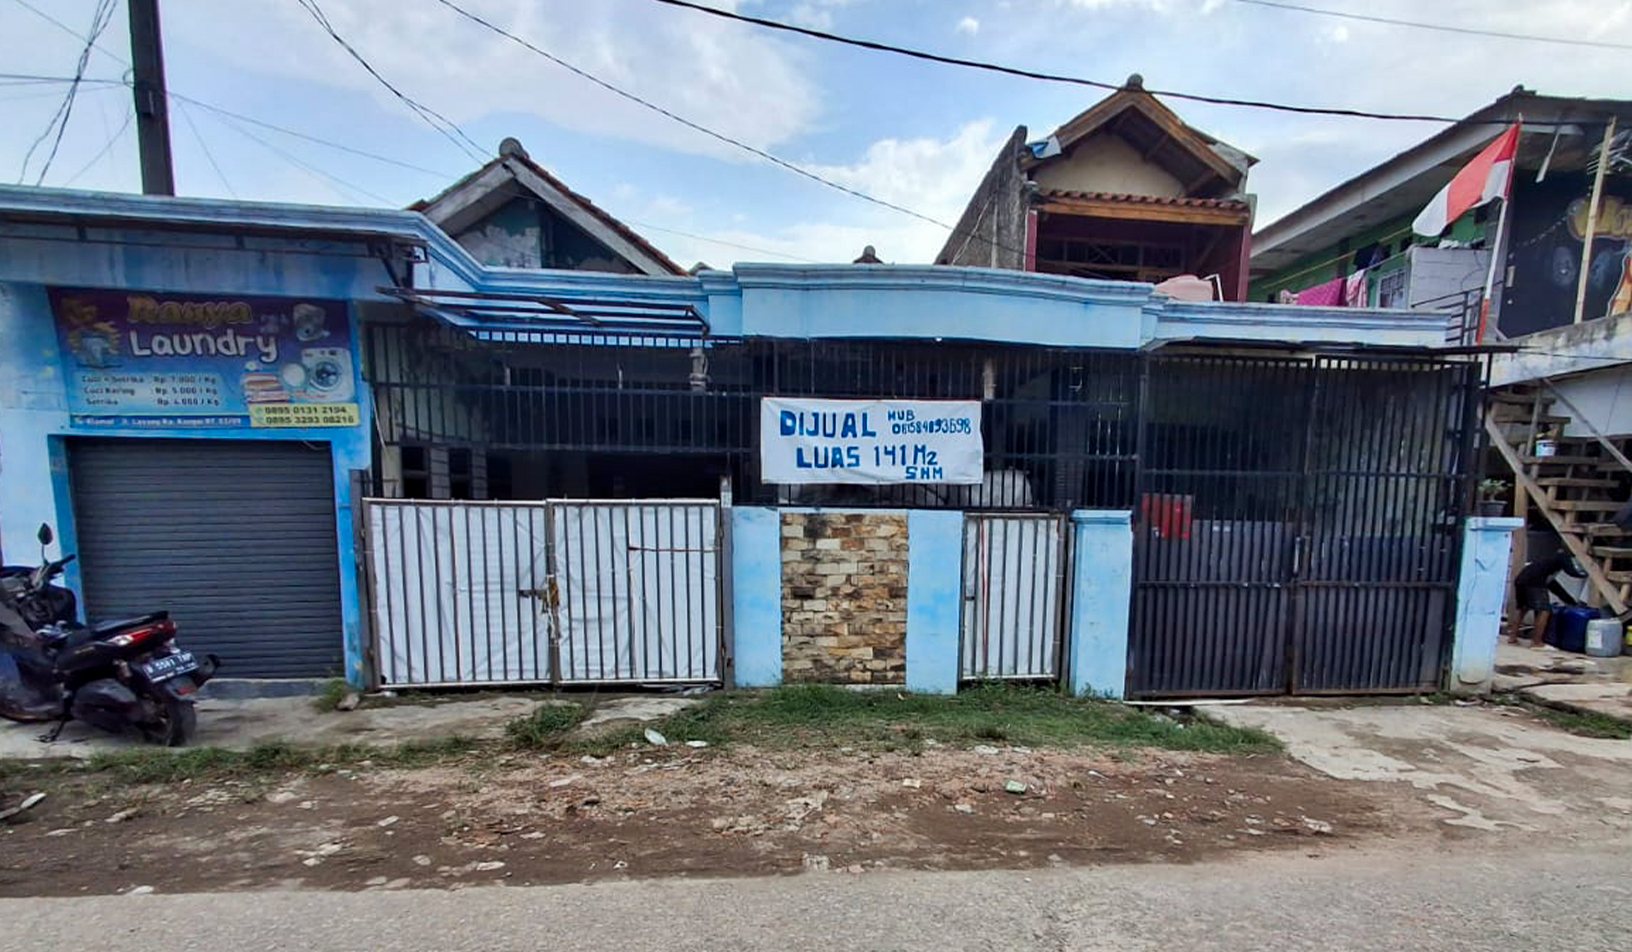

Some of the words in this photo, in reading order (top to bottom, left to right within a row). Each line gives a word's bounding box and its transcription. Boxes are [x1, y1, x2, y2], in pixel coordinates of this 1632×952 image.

[129, 328, 277, 363] Laundry
[780, 409, 877, 438] DIJUAL
[887, 409, 916, 422] HUB
[796, 445, 860, 468] LUAS
[873, 444, 907, 467] 141
[905, 466, 943, 480] SHM
